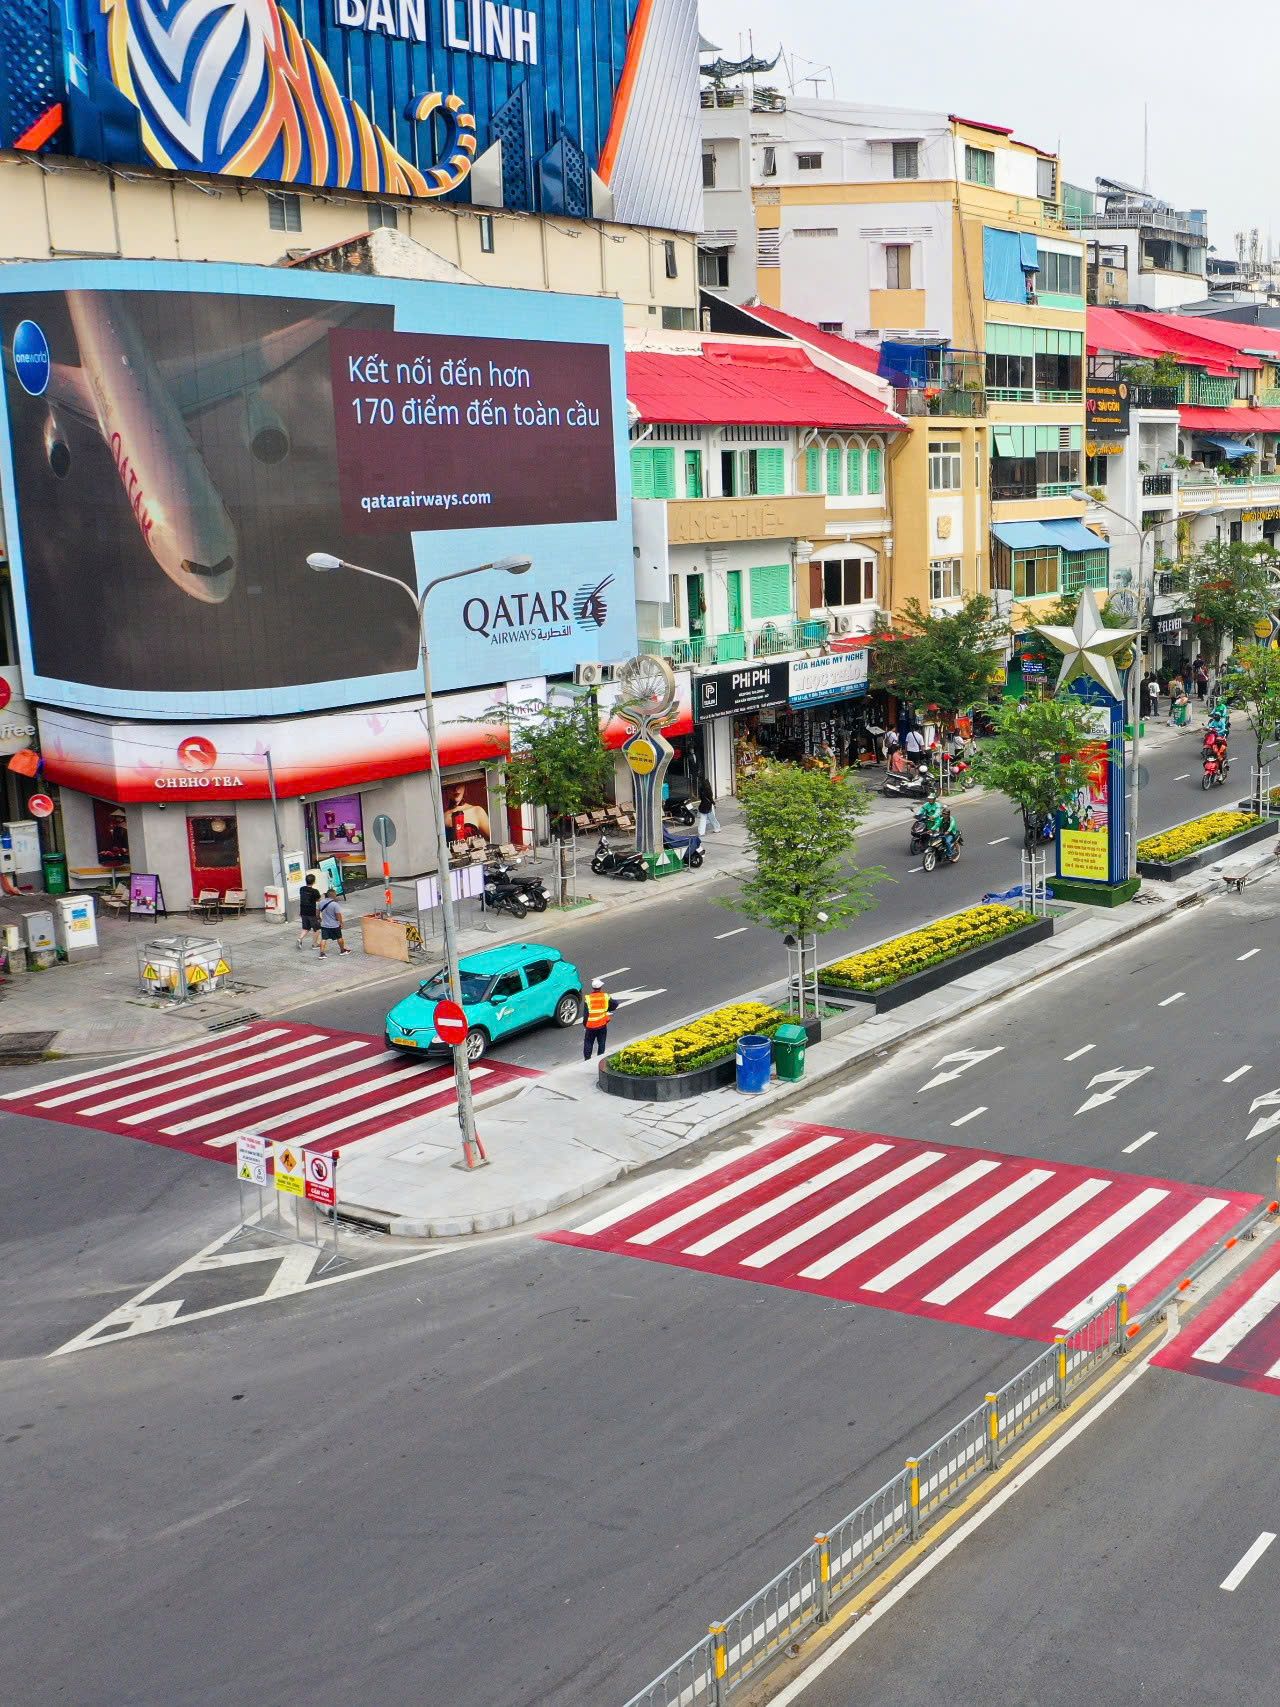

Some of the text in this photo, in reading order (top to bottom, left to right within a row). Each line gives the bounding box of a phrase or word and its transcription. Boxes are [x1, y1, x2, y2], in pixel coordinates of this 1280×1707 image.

[16, 352, 48, 364] oneworld
[348, 354, 531, 388] Kết nối đến hơn
[351, 394, 601, 427] 170 điểm đến toàn cầu
[361, 491, 492, 513] qatarairways.com
[463, 590, 571, 638] QATAR
[490, 629, 537, 645] AIRWAYS
[154, 775, 244, 790] CHEHO TEA
